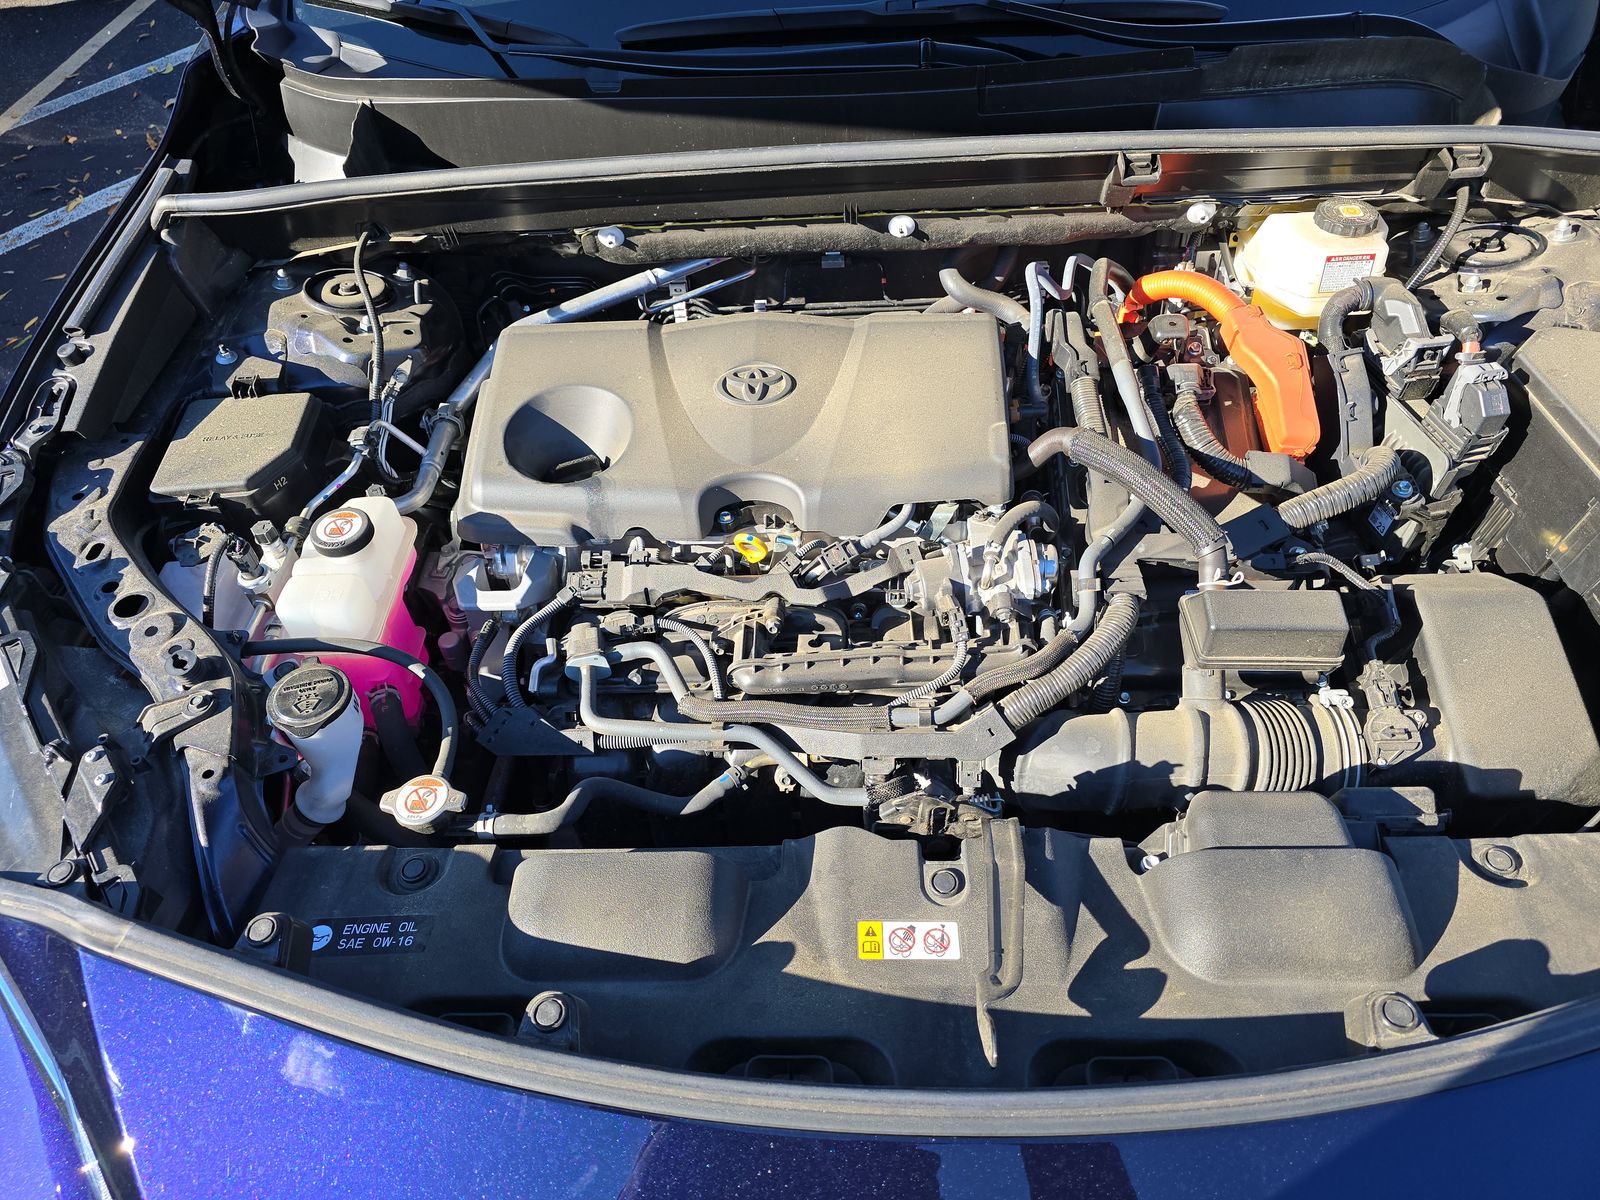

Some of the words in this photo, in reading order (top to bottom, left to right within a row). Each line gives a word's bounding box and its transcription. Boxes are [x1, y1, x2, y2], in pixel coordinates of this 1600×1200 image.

[273, 476, 288, 491] H2
[342, 922, 391, 935] ENGINE
[398, 921, 418, 932] OIL
[337, 937, 365, 949] SAE
[372, 935, 414, 948] 0W-16
